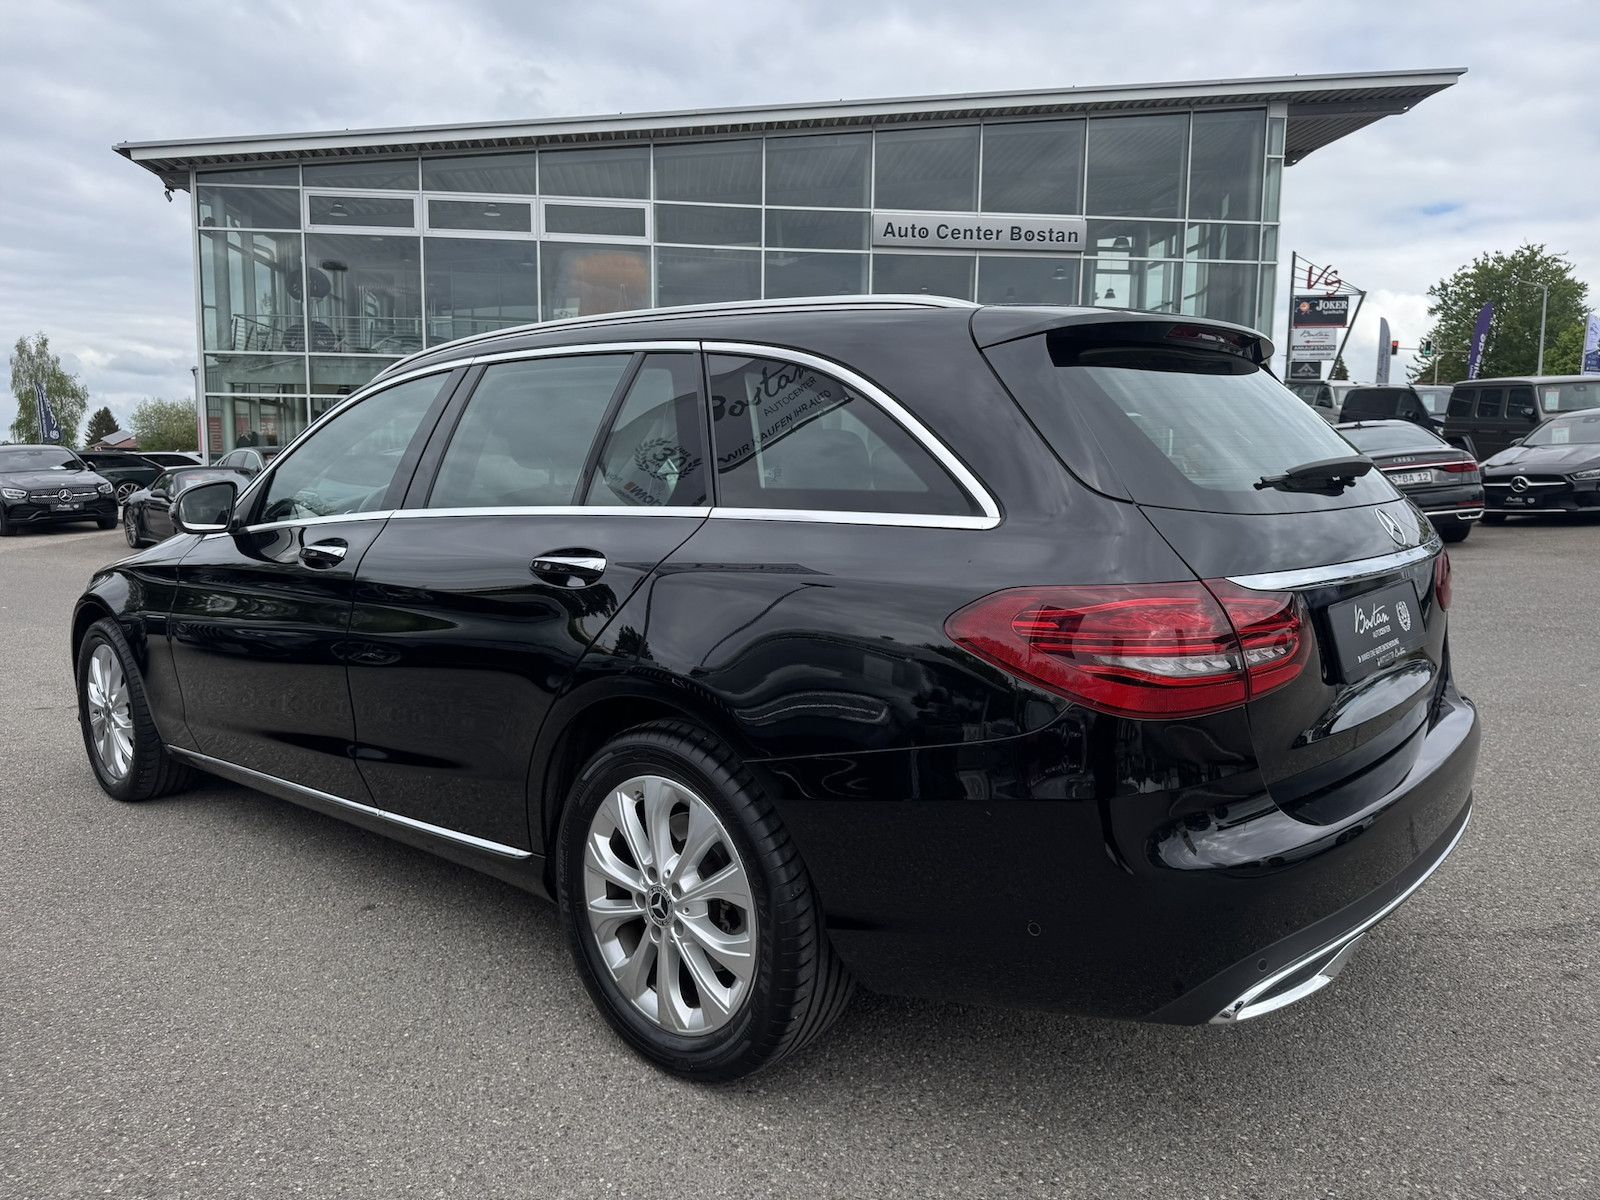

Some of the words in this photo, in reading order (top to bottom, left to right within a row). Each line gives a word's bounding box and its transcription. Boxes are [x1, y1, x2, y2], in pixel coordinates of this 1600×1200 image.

[882, 221, 930, 240] Auto
[936, 223, 1003, 242] Center
[1009, 225, 1079, 243] Bostan
[1315, 299, 1348, 311] JOKER
[763, 376, 817, 417] AUTOCENTER
[752, 414, 794, 446] KAUFEN
[794, 403, 808, 420] IHR
[809, 390, 832, 409] AUTO
